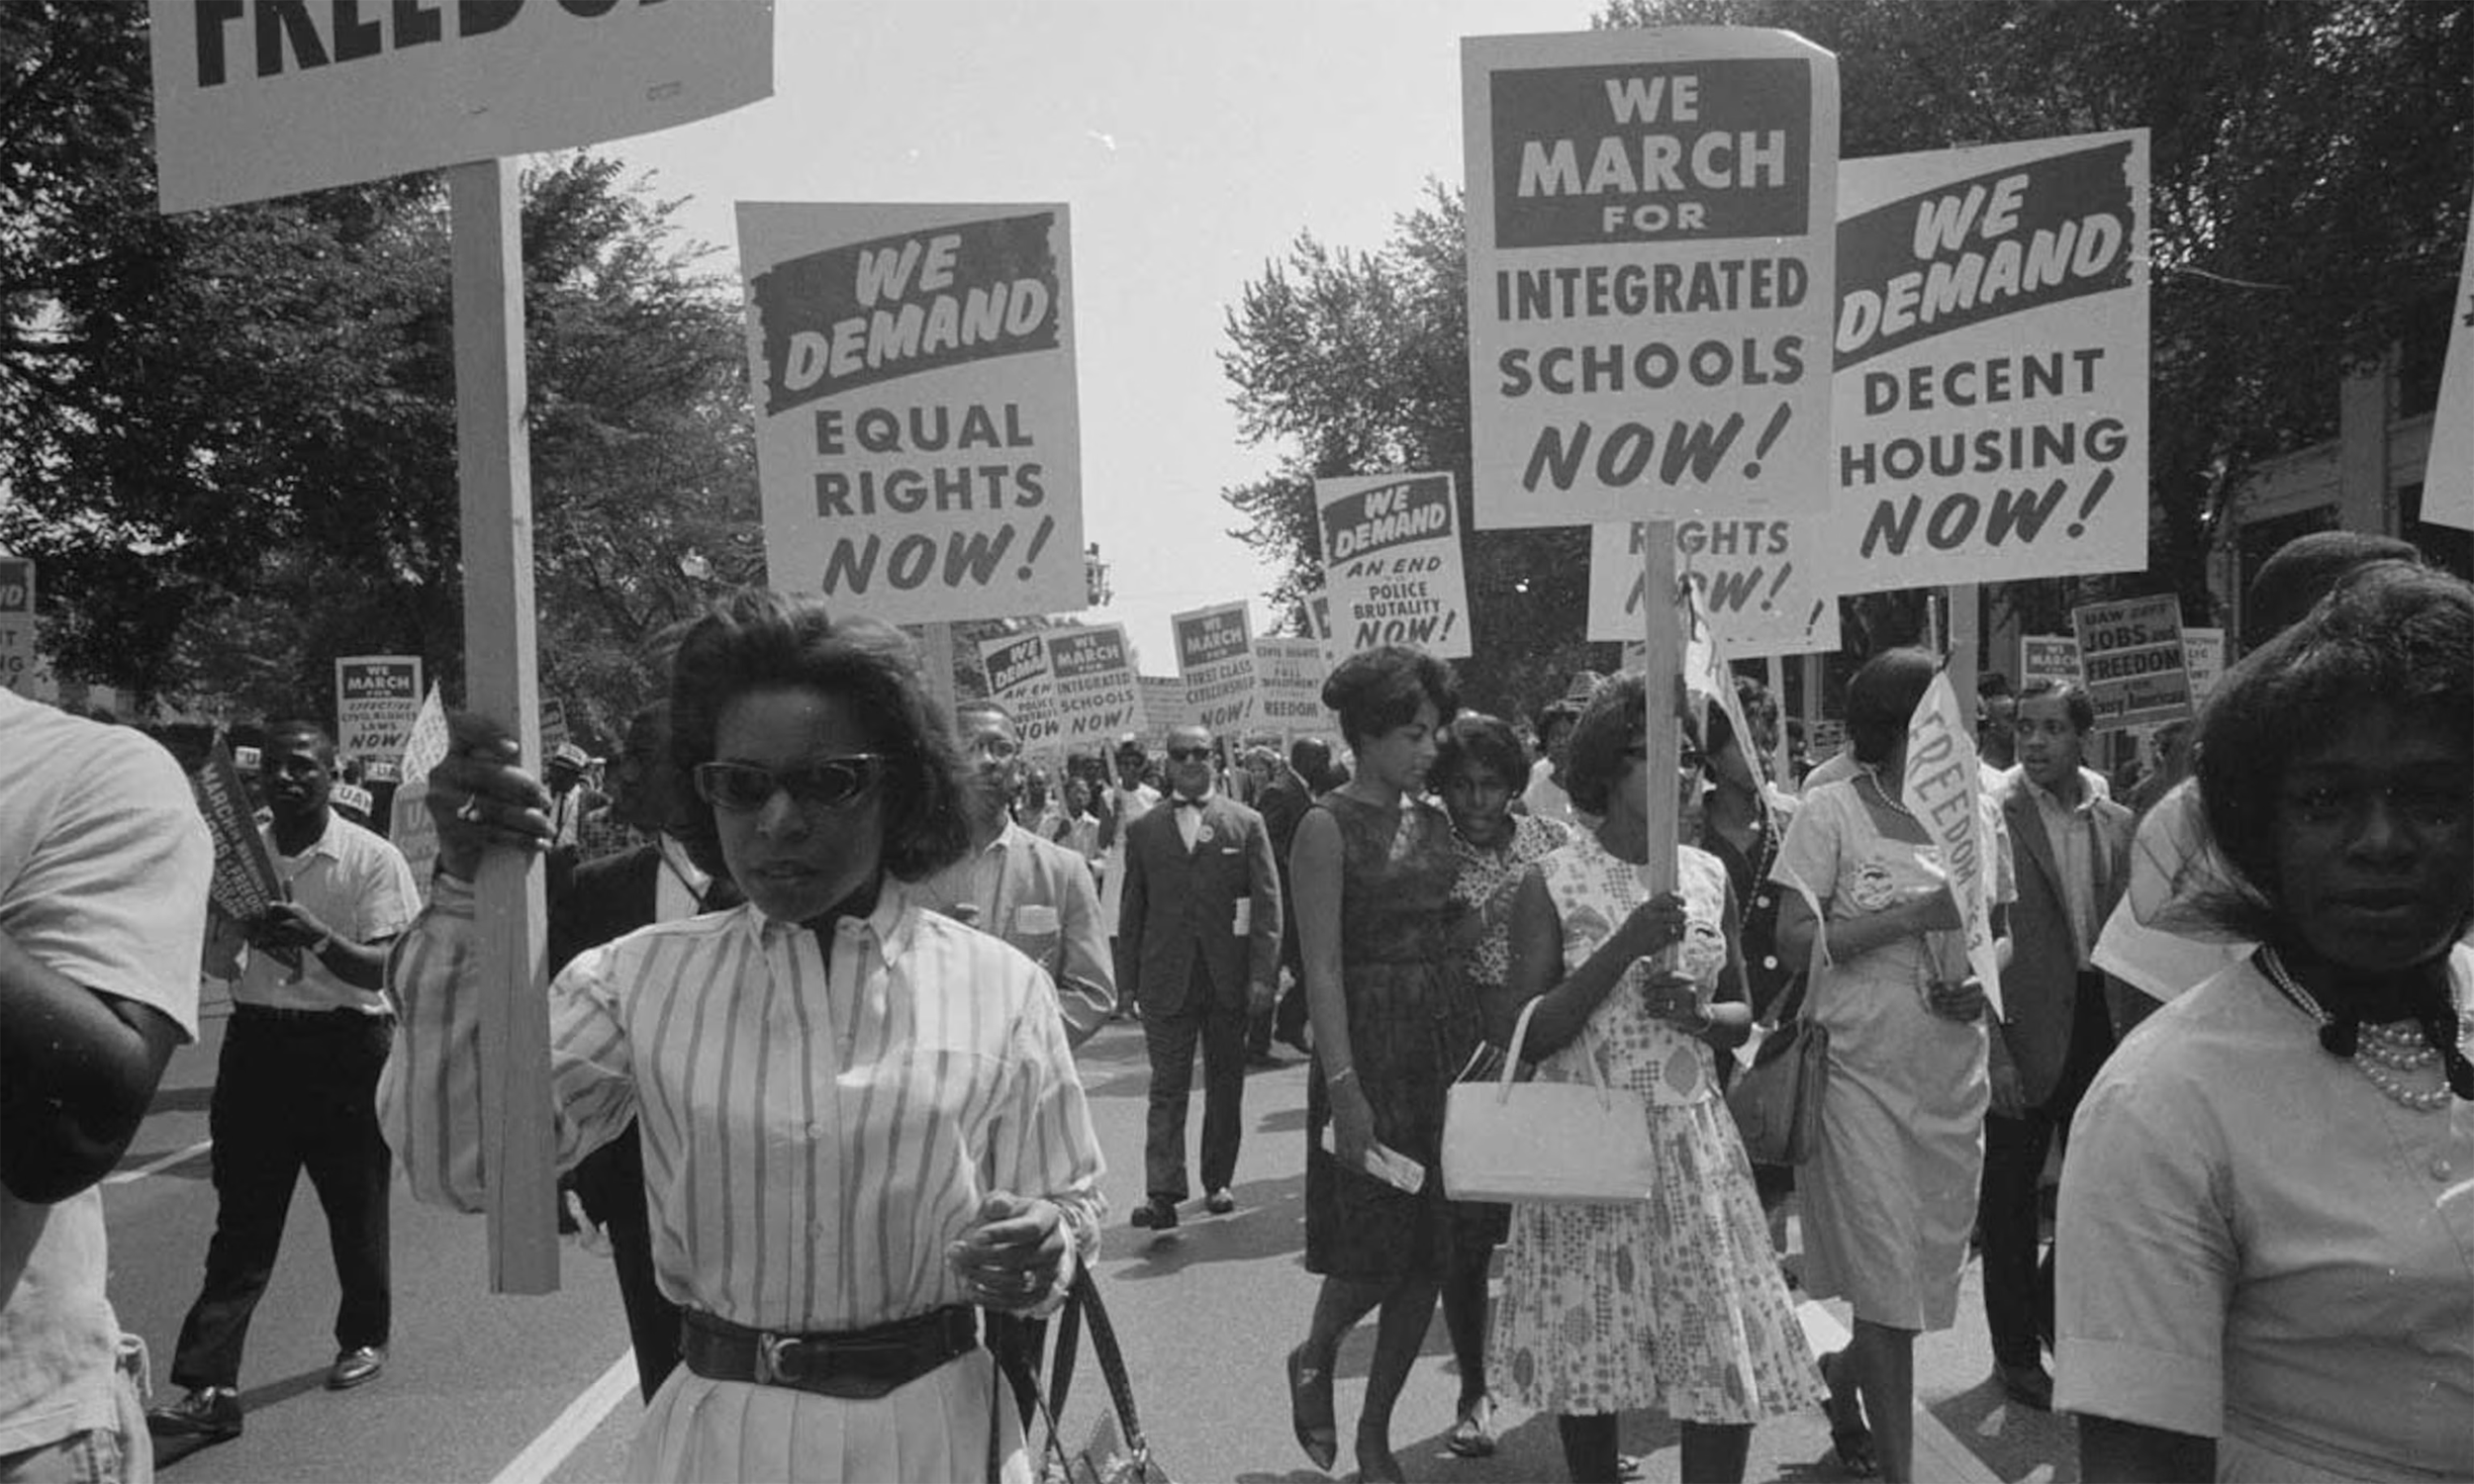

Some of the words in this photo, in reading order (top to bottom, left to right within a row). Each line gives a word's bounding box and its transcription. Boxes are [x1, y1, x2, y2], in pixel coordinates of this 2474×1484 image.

[1604, 75, 1698, 124] WE
[1517, 130, 1785, 196] MARCH
[1602, 203, 1708, 232] FOR
[1913, 174, 2029, 259] WE
[856, 234, 961, 307] WE
[1835, 213, 2122, 352] DEMAND
[1496, 257, 1809, 321] INTEGRATED
[784, 278, 1048, 390] DEMAND
[1498, 335, 1805, 397] SCHOOLS
[1864, 348, 2105, 417] DECENT
[815, 404, 1034, 455] EQUAL
[1522, 401, 1792, 492] NOW!
[1840, 417, 2127, 487] HOUSING
[813, 463, 1044, 516] RIGHTS
[1365, 485, 1410, 518] WE
[1859, 468, 2114, 559] NOW!
[1336, 503, 1446, 558] DEMAND
[1629, 520, 1790, 555] RGHTS
[822, 515, 1054, 595] NOW!
[1347, 559, 1384, 578] AN
[1393, 557, 1442, 574] END
[1370, 582, 1428, 601] POLICE
[1203, 617, 1222, 629] WE
[1353, 600, 1441, 620] BRUTALITY
[2085, 610, 2125, 625] UAW
[1073, 635, 1096, 648] WE
[1188, 627, 1243, 651] MARCH
[1355, 608, 1457, 649] NOW!
[2087, 624, 2146, 652] JOBS
[1009, 638, 1039, 665] WE
[1057, 646, 1120, 667] MARCH
[2087, 648, 2181, 680] FREEDOM
[347, 676, 410, 691] MARCH
[366, 666, 389, 676] WE
[1057, 673, 1131, 693] INTEGRATED
[1187, 668, 1217, 686] FIRST
[1219, 660, 1253, 677] CLASS
[1032, 683, 1052, 696] EN
[1061, 691, 1135, 712] SCHOOLS
[1187, 676, 1256, 704] CITIZENSHIP
[1072, 706, 1134, 734] NOW!
[1200, 696, 1254, 727] NOW!
[201, 762, 240, 831] MARCH
[1908, 709, 1977, 887] FREEDOM
